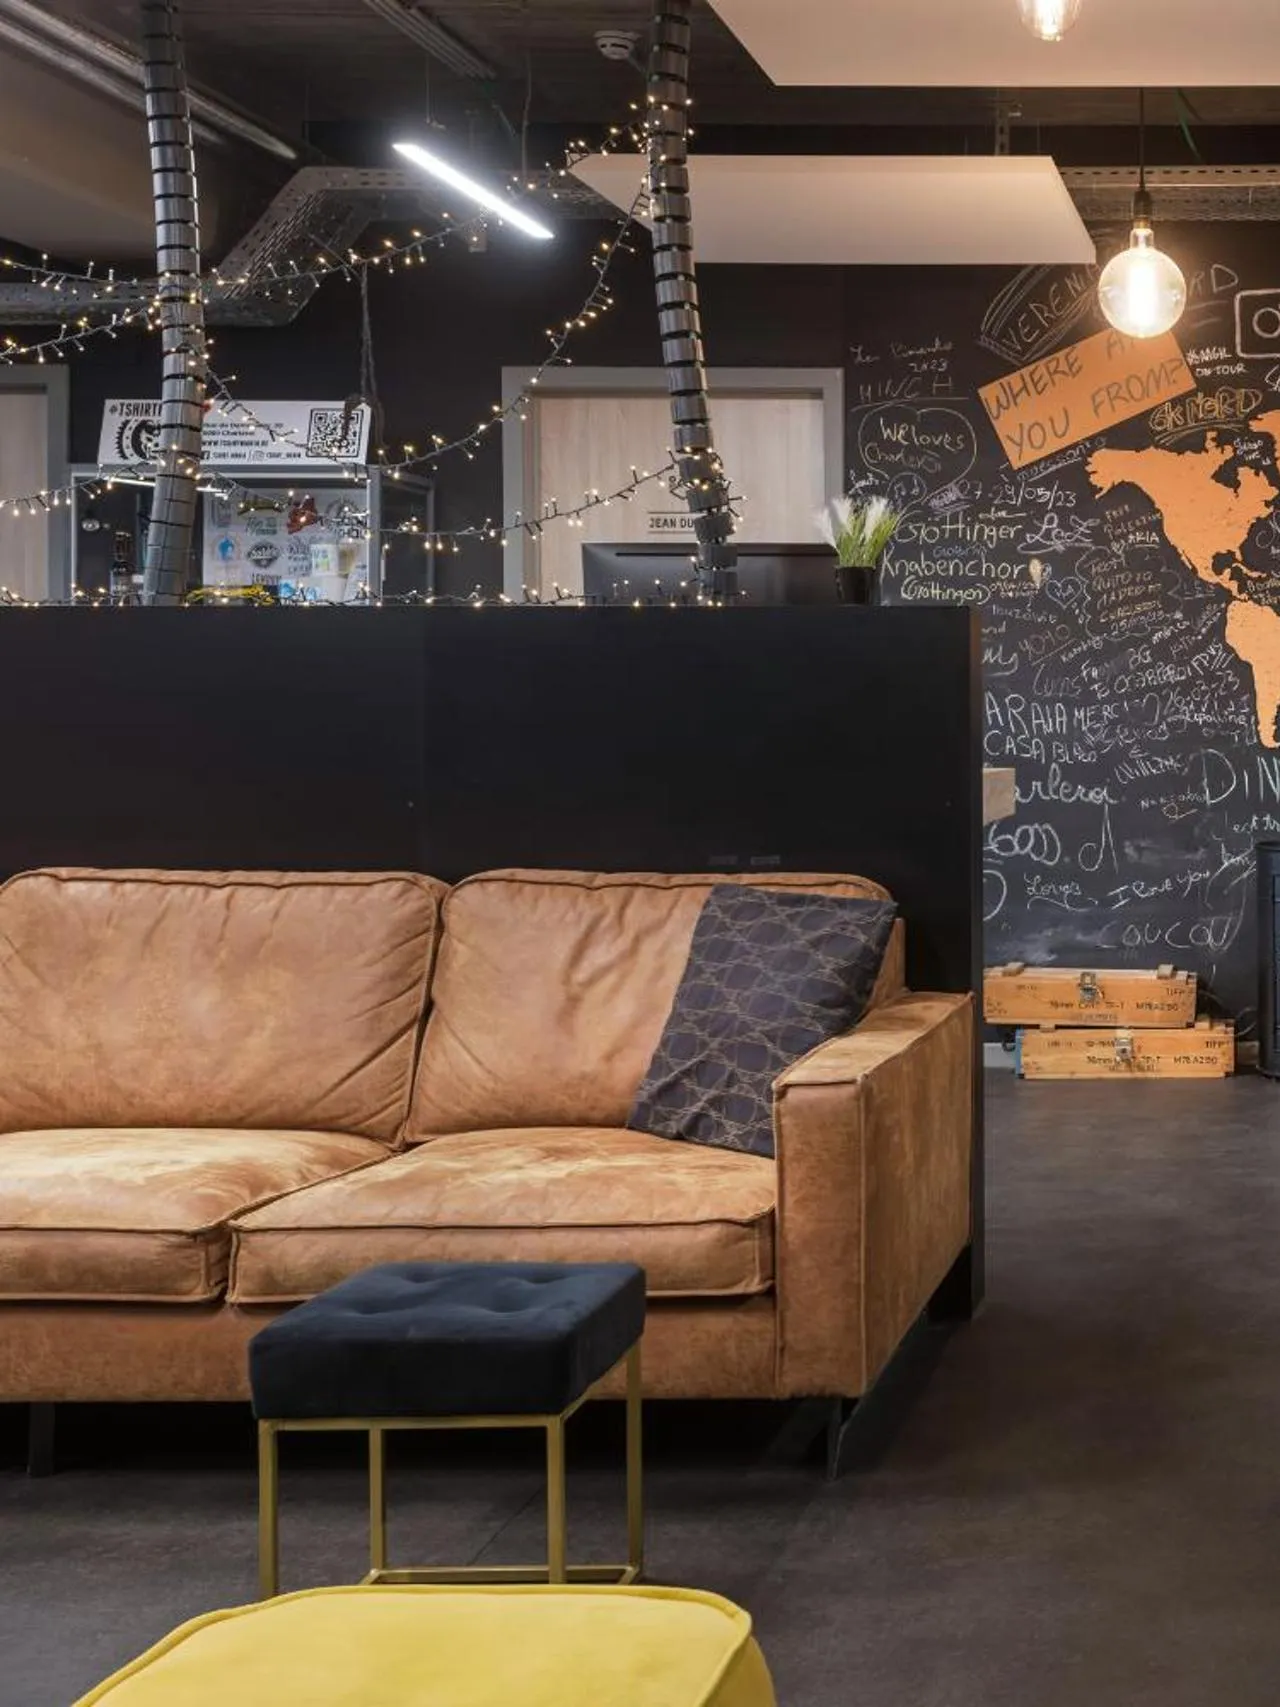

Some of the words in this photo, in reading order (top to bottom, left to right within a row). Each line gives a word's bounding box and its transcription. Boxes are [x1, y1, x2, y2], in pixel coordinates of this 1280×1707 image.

[984, 350, 1083, 421] WHERE
[1006, 407, 1071, 461] YOU
[1091, 358, 1185, 418] FROM?
[649, 518, 677, 529] JEAN
[680, 518, 696, 529] DU
